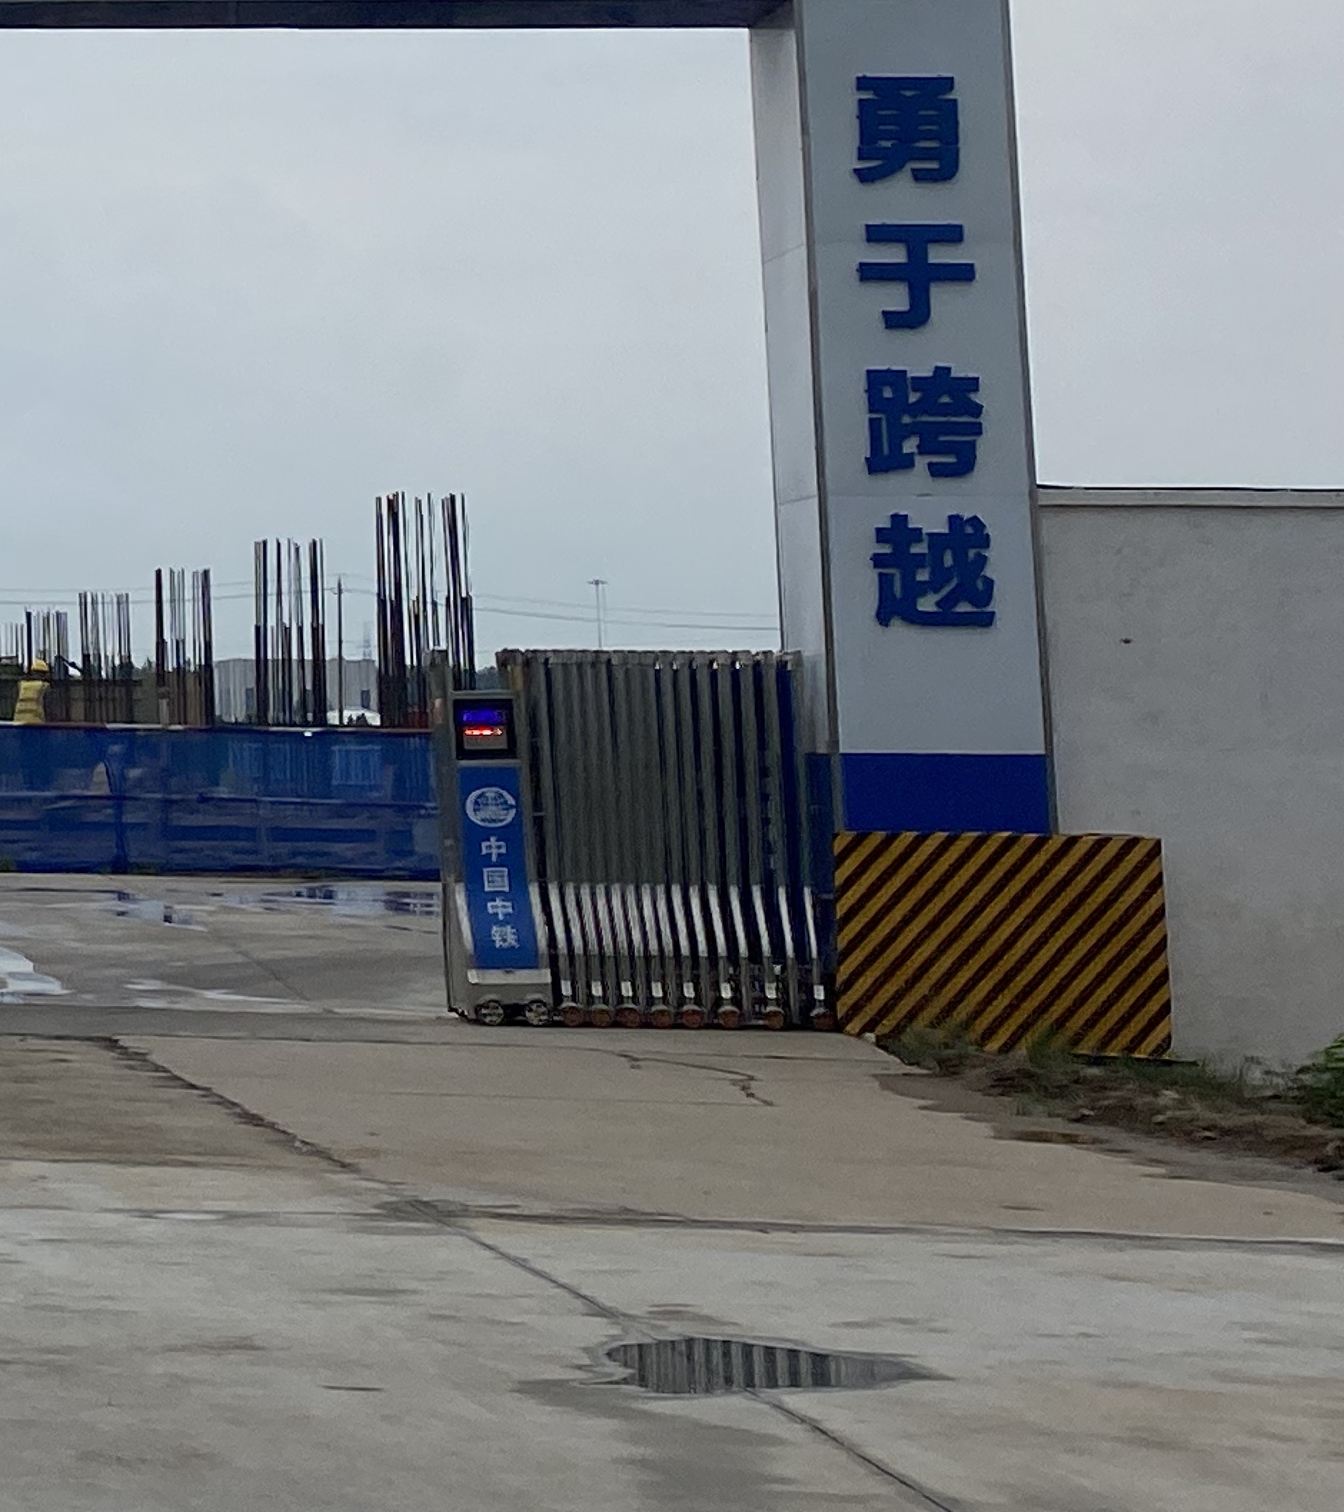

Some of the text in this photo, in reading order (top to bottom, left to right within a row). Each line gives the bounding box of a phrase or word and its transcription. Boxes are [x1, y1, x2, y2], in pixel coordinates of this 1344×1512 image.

[853, 75, 996, 627] 勇于跨越
[481, 836, 520, 949] 中国中铁
